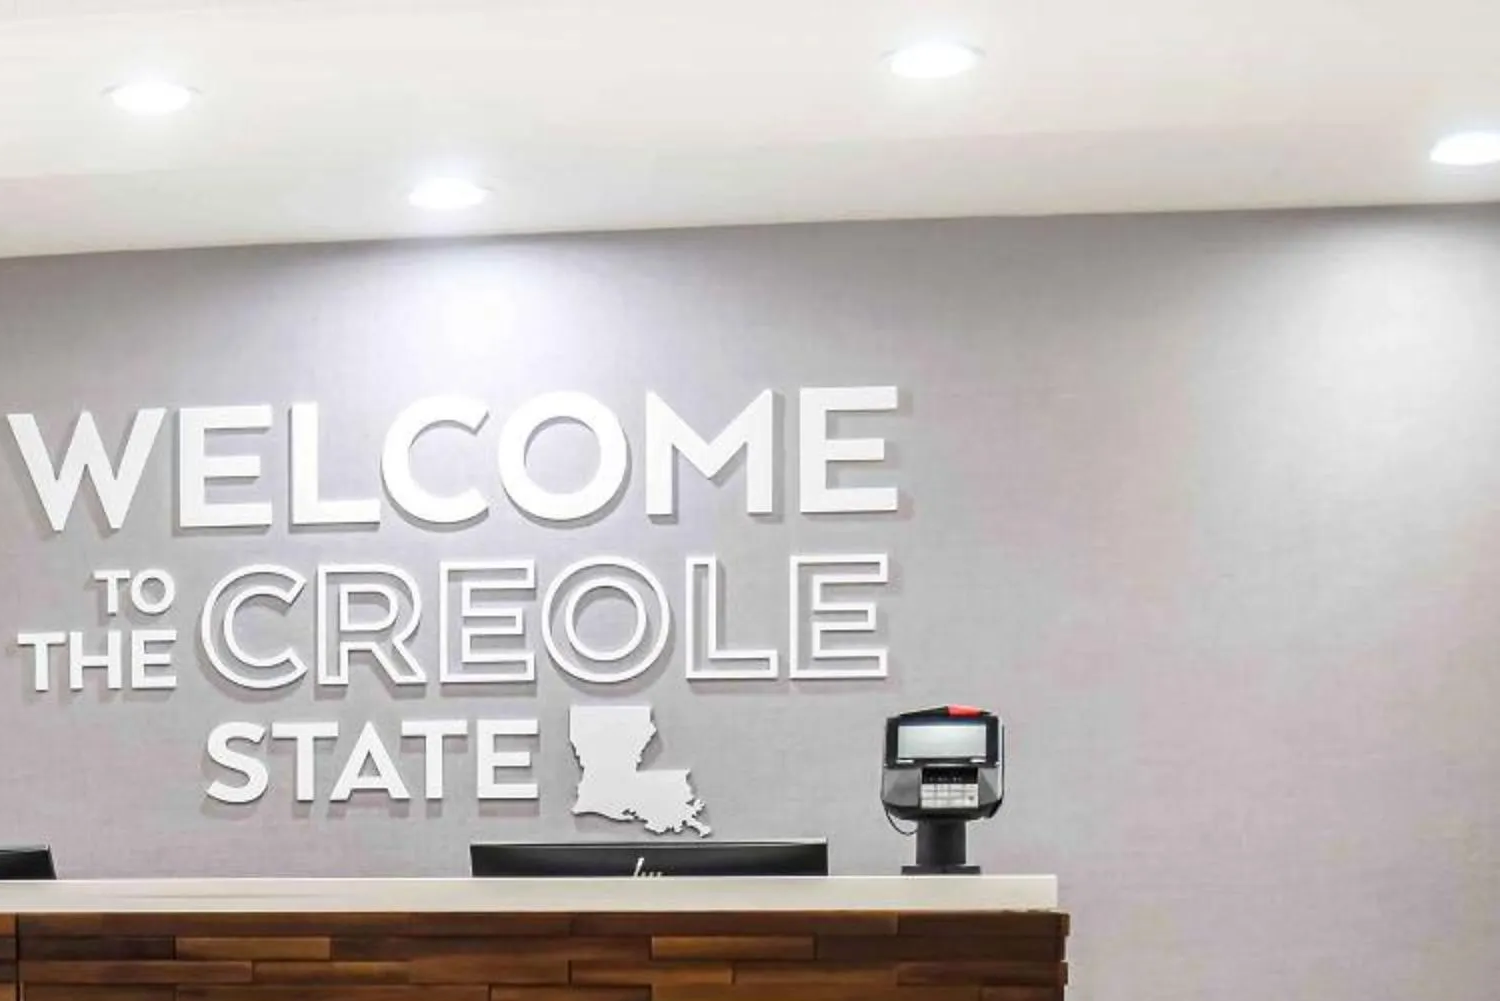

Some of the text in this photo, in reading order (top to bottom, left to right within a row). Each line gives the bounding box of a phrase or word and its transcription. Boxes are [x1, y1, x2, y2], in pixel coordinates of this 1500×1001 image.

[7, 386, 899, 532] WELCOME
[94, 569, 176, 615] TO
[201, 554, 889, 689] CREOLE
[18, 631, 177, 691] THE
[205, 719, 540, 804] STATE
